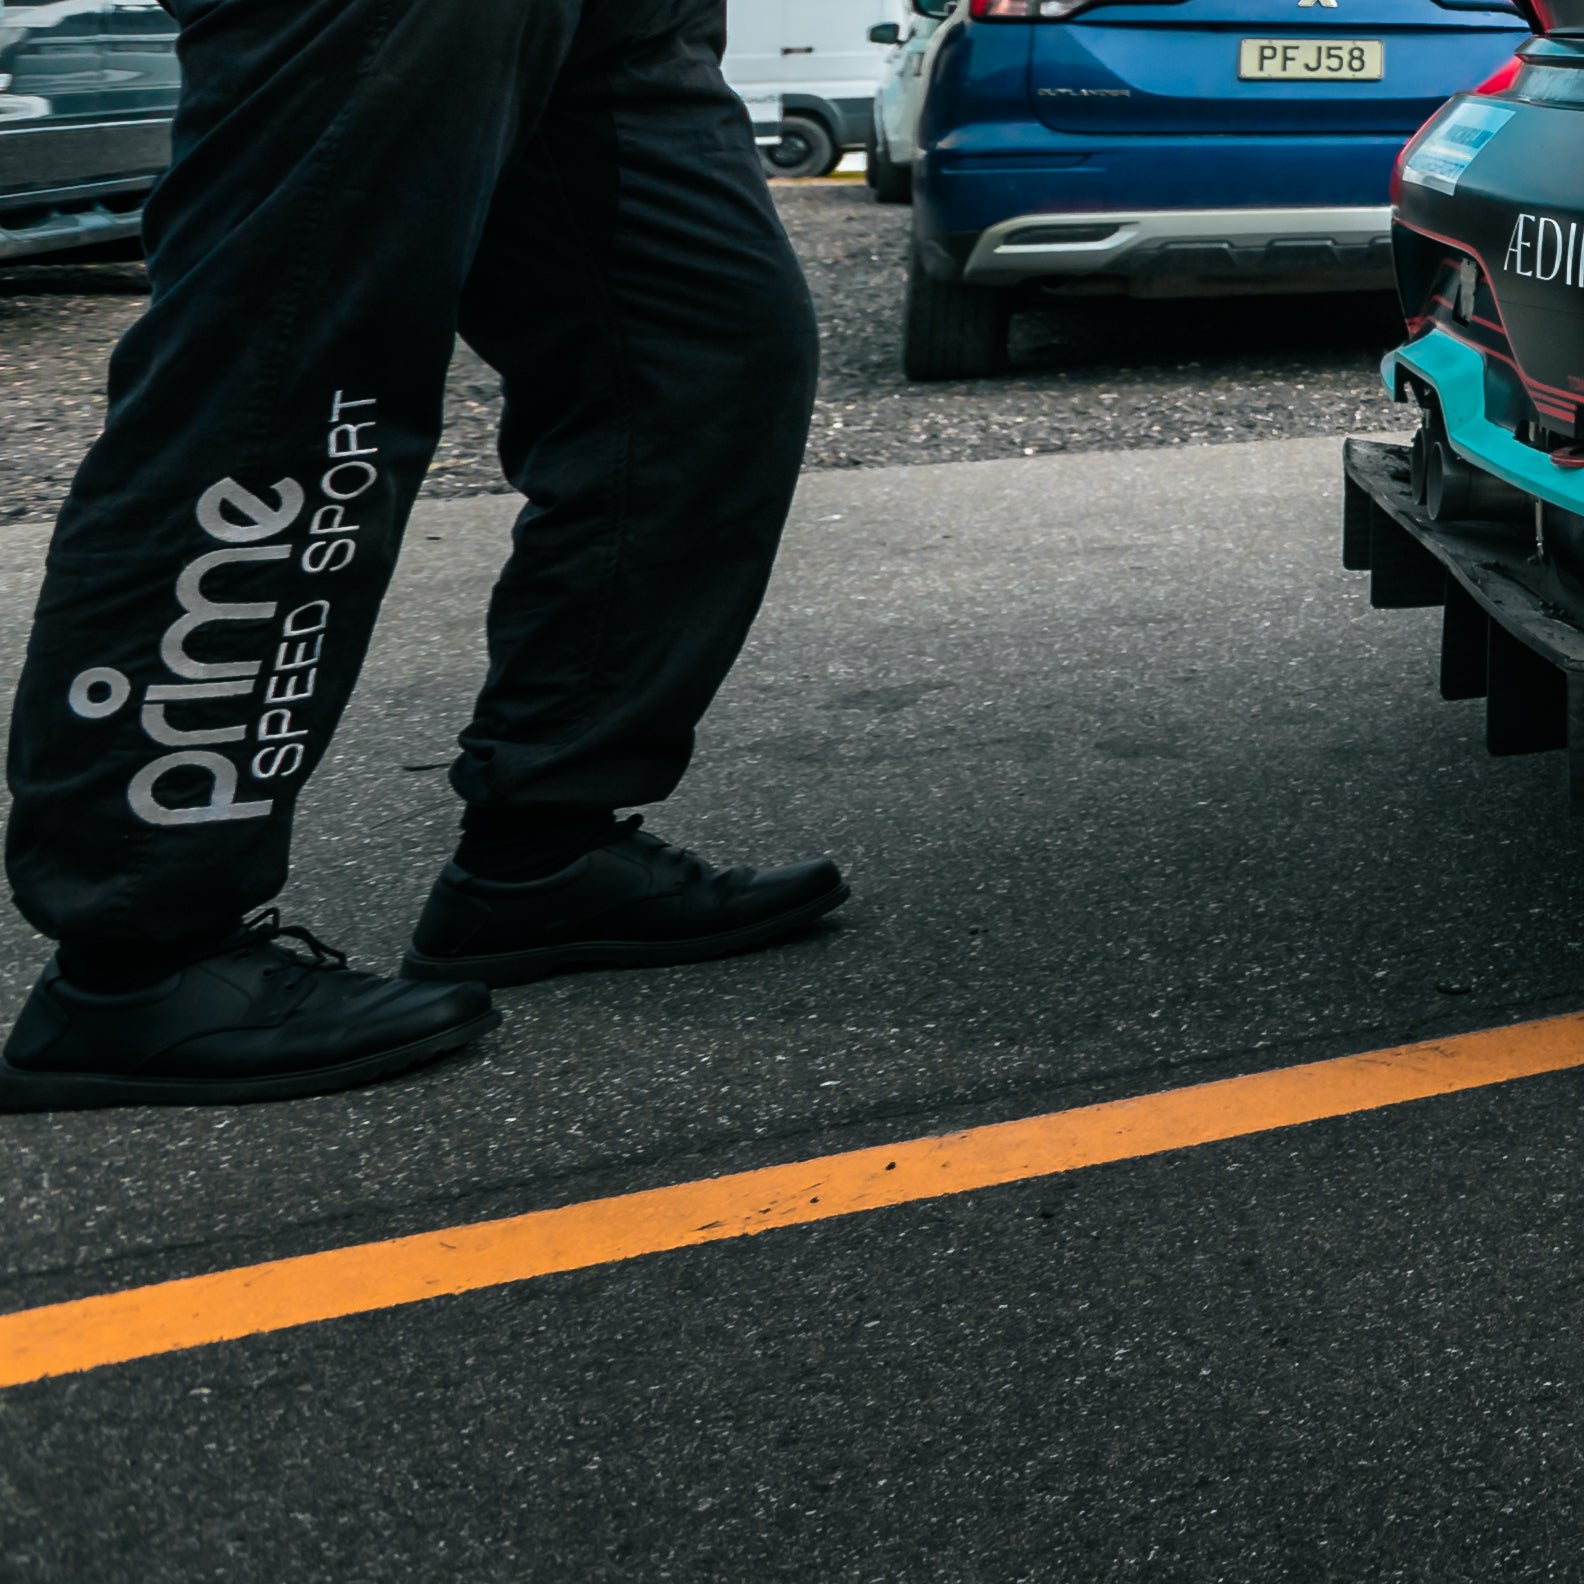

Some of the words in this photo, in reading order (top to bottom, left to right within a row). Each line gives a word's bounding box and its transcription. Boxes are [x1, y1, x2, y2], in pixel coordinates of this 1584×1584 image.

[1258, 45, 1366, 73] PFJ58
[68, 477, 305, 825] prime
[251, 600, 329, 778] SPEED
[302, 390, 377, 572] SPORT
